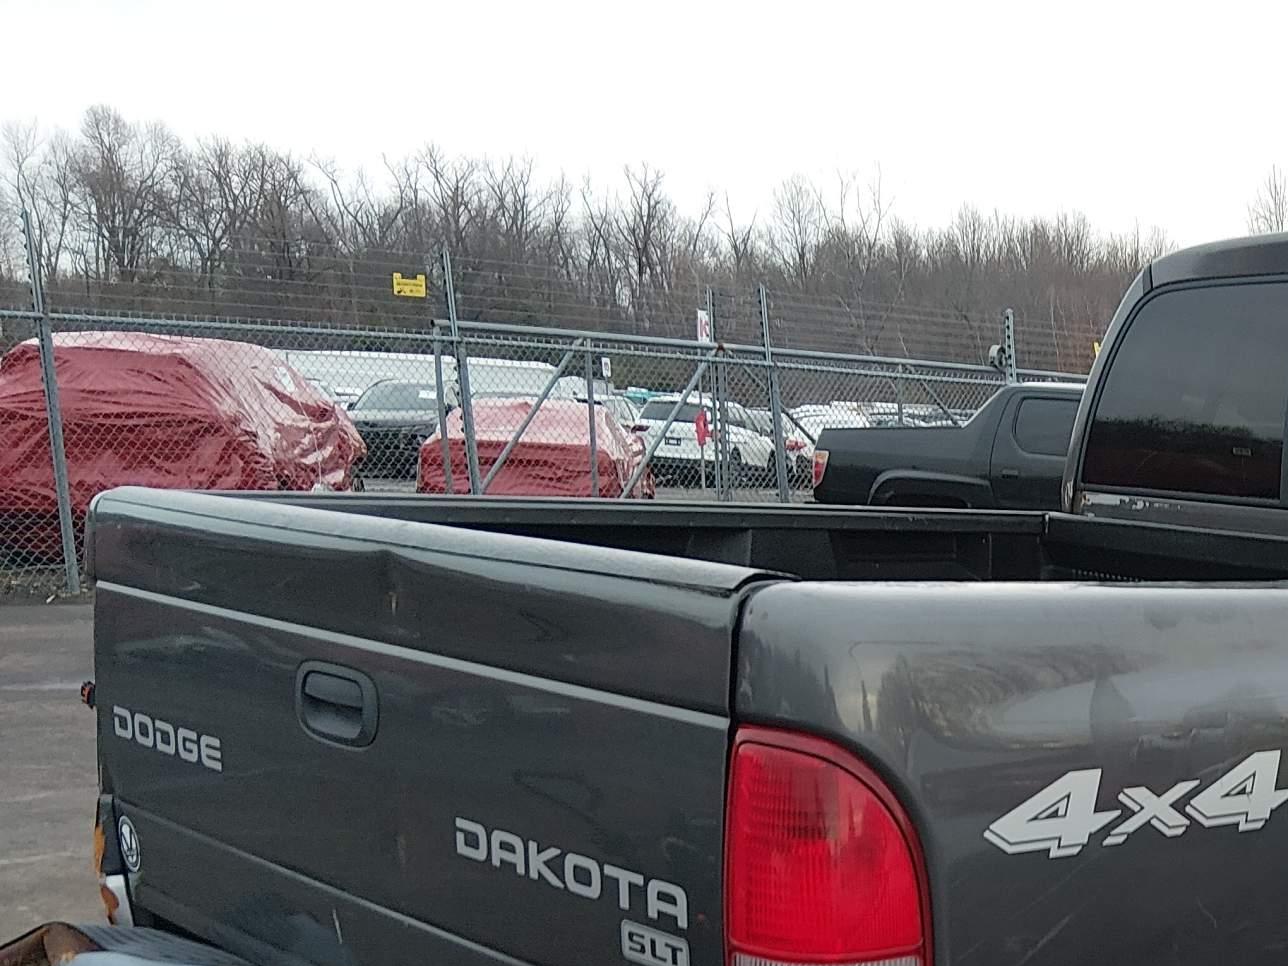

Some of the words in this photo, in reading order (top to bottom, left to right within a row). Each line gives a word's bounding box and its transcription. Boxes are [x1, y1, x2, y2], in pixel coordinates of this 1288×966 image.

[113, 705, 222, 772] DODGE
[455, 816, 688, 930] DAKOTA
[628, 930, 684, 966] SLT
